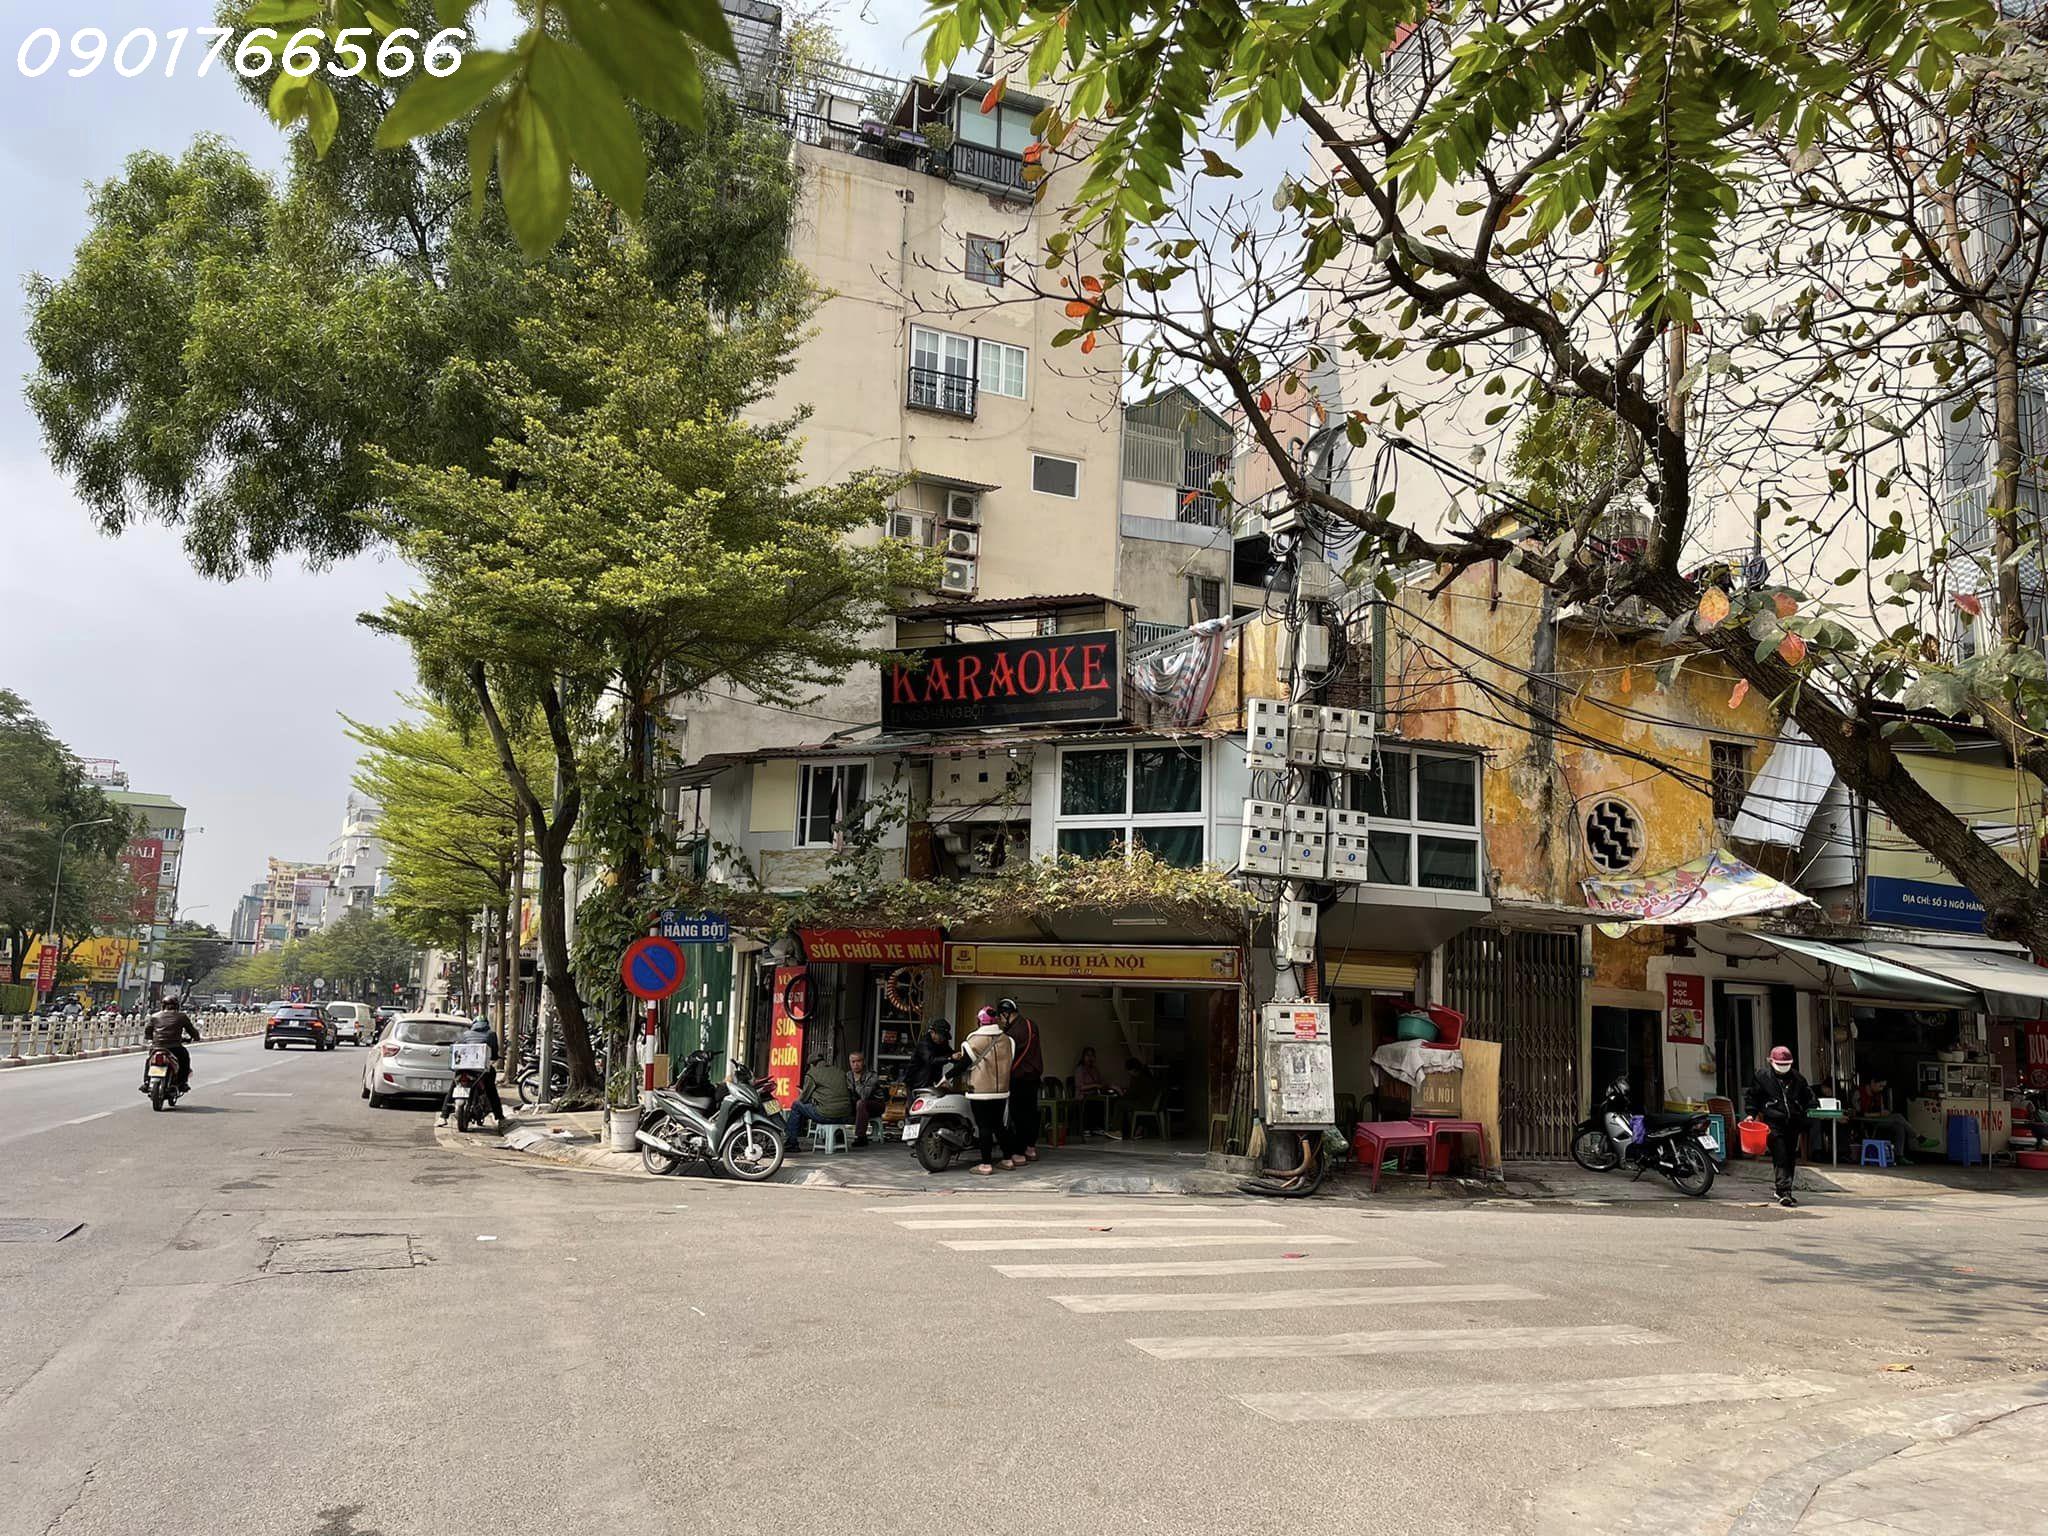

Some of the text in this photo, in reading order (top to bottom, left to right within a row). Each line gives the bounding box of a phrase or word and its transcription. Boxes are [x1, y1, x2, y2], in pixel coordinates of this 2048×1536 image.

[891, 643, 1112, 705] KARAOKE
[1902, 893, 1915, 904] ĐỊA
[1932, 896, 1942, 907] SỐ
[1942, 899, 1948, 907] 3
[664, 921, 725, 939] HÀNG BỘT
[810, 937, 940, 959] SỬA CHỮA XE MÁY
[1019, 953, 1145, 971] BIA HƠI HÀ NỘI
[771, 1043, 798, 1066] CHỮA
[776, 1077, 790, 1097] XE
[1980, 1107, 2003, 1131] MNG
